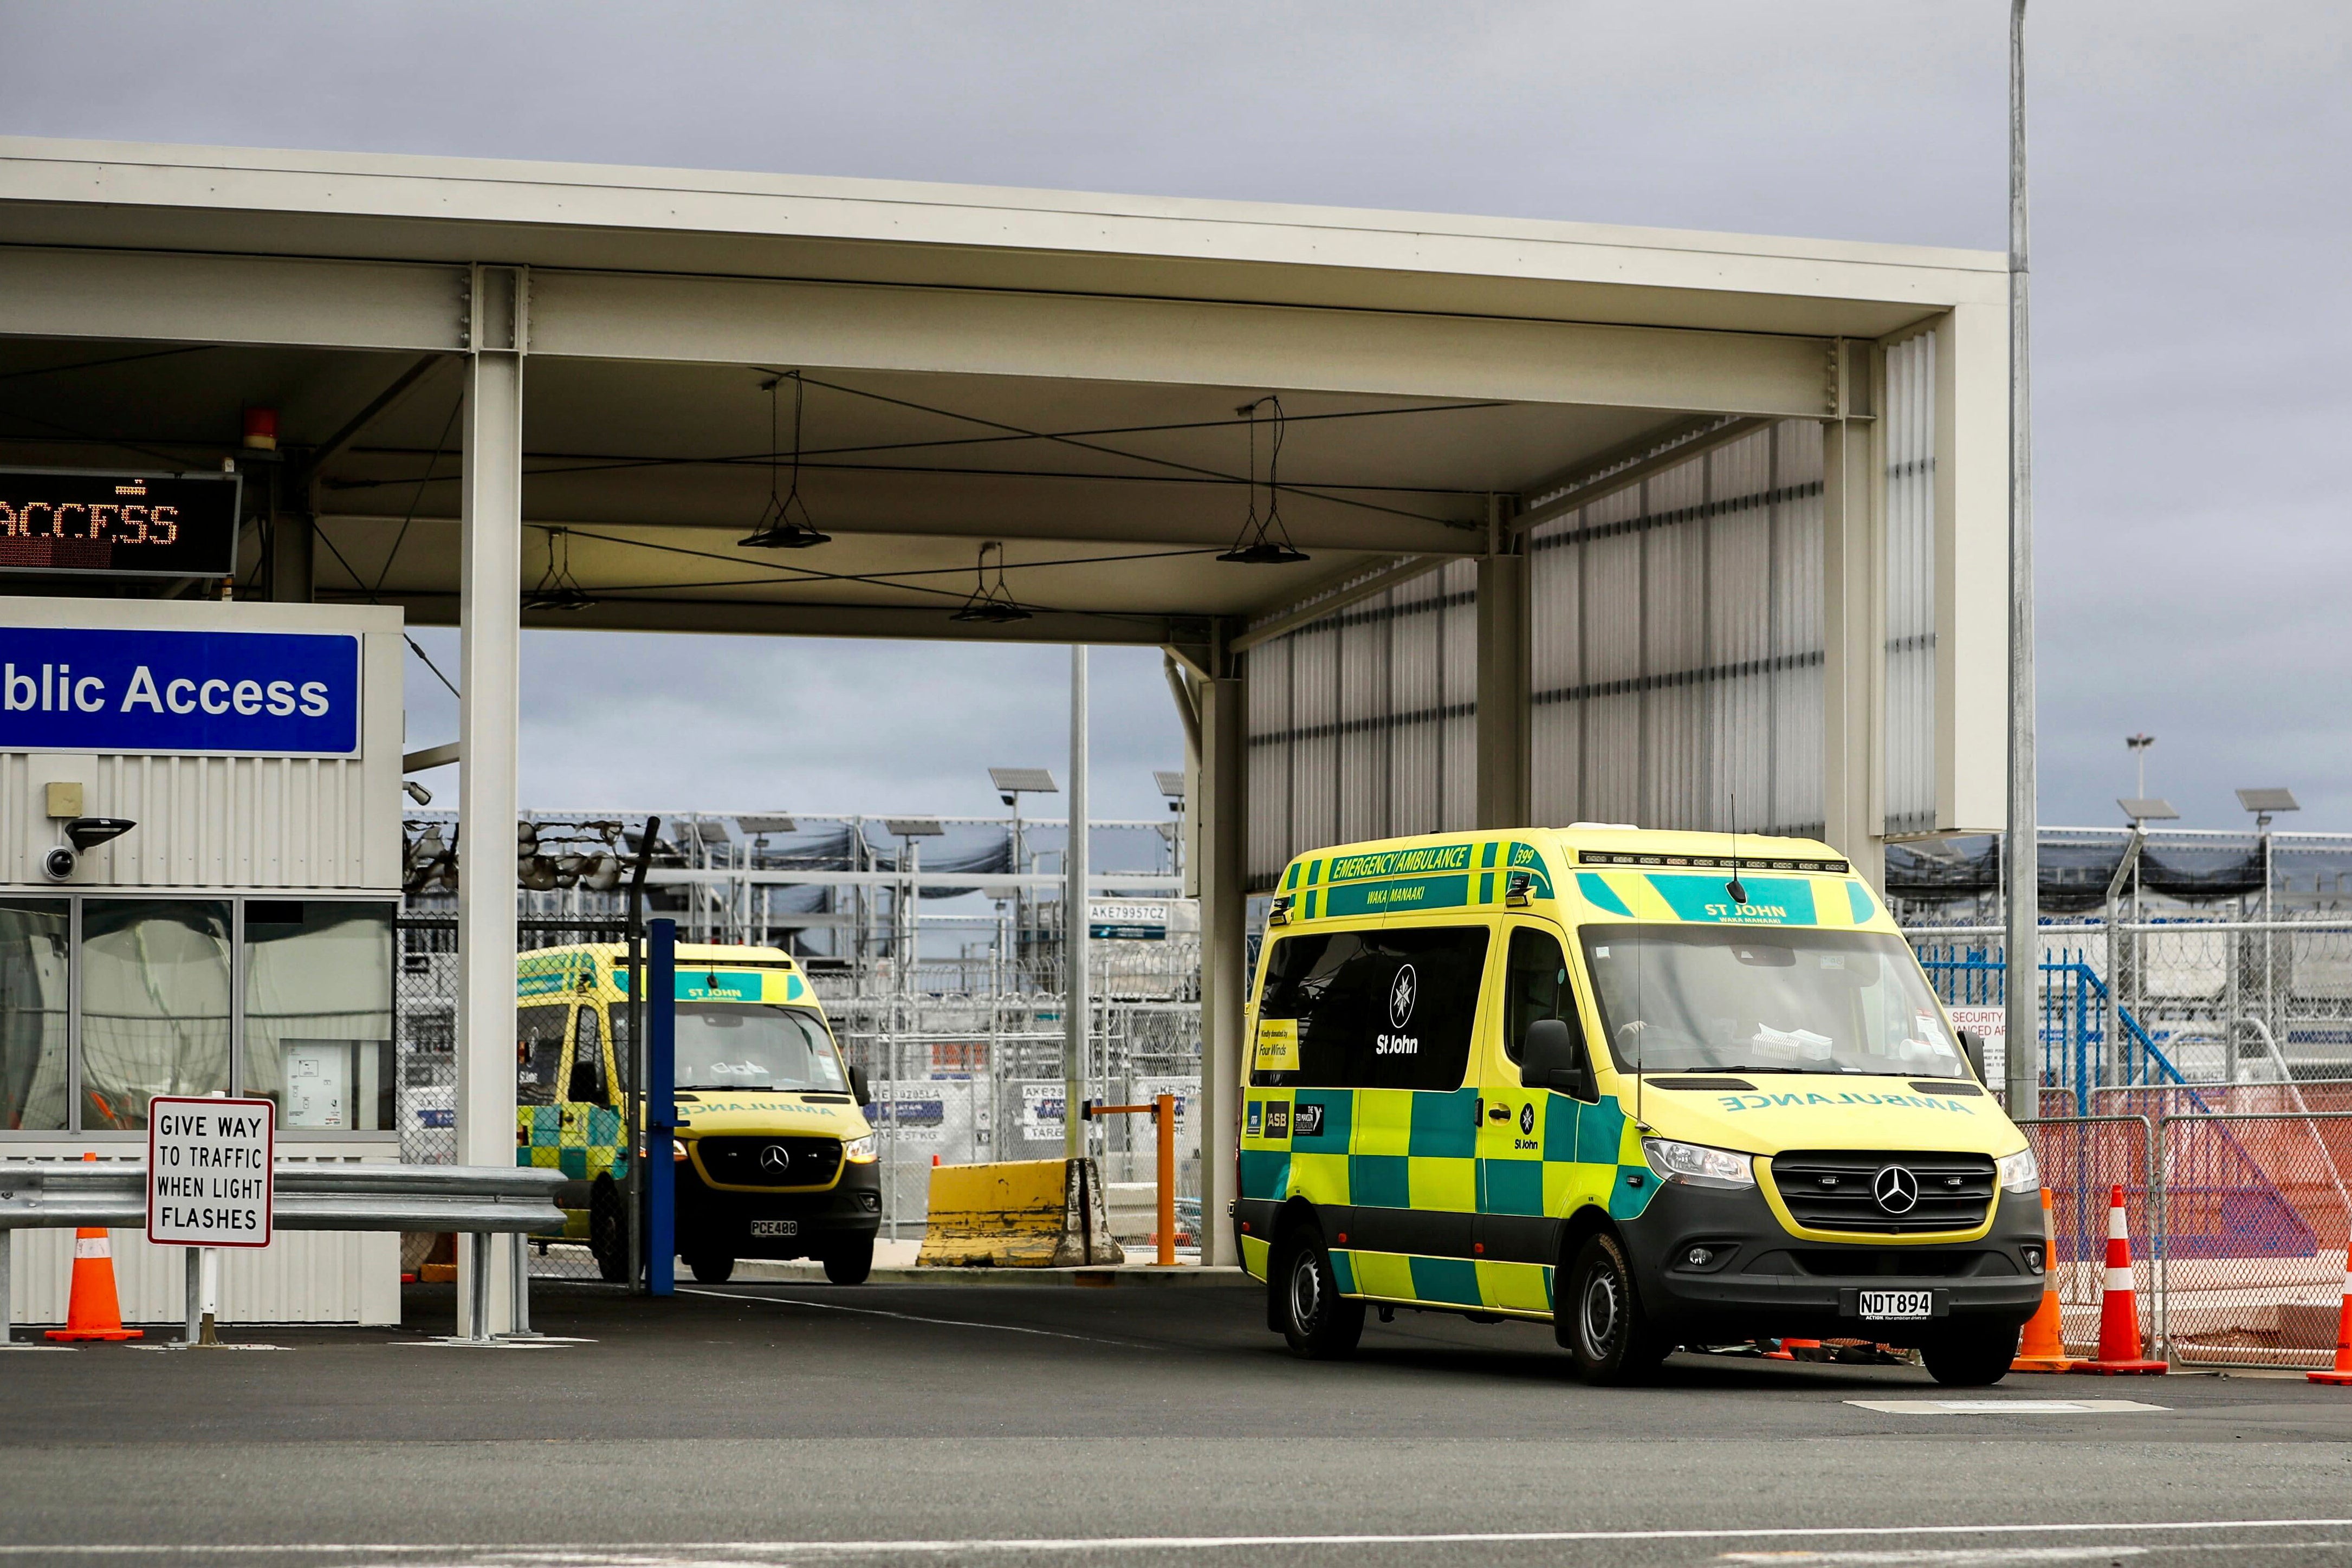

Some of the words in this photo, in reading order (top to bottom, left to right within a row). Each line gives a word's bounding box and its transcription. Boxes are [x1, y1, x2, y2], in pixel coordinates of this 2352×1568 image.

[120, 666, 329, 716] Access
[1333, 853, 1397, 879] EMERGENCY
[1396, 847, 1467, 872] AMBULANCE
[1515, 848, 1534, 864] 399
[1366, 890, 1387, 904] WAKA
[1389, 886, 1425, 902] MANAAKI
[1092, 906, 1164, 919] AKE79957CZ
[1705, 904, 1727, 916] ST
[1735, 904, 1787, 917] JOHN
[688, 988, 704, 996] ST
[708, 988, 742, 997] JOHN
[1953, 1012, 2003, 1022] SECURITY
[1259, 1044, 1271, 1055] Four
[1271, 1044, 1286, 1055] Winds
[1376, 1034, 1388, 1054] St
[1389, 1034, 1418, 1054] John
[160, 1115, 207, 1136] GIVE
[218, 1117, 262, 1138] WAY
[1268, 1113, 1286, 1127] ASB
[1515, 1138, 1521, 1149] St
[1522, 1139, 1538, 1149] John
[160, 1146, 180, 1166] TO
[190, 1146, 262, 1169] TRAFFIC
[158, 1176, 203, 1197] WHEN
[213, 1178, 262, 1199] LIGHT
[162, 1207, 256, 1230] FLASHES
[1861, 1294, 1929, 1313] NDT894
